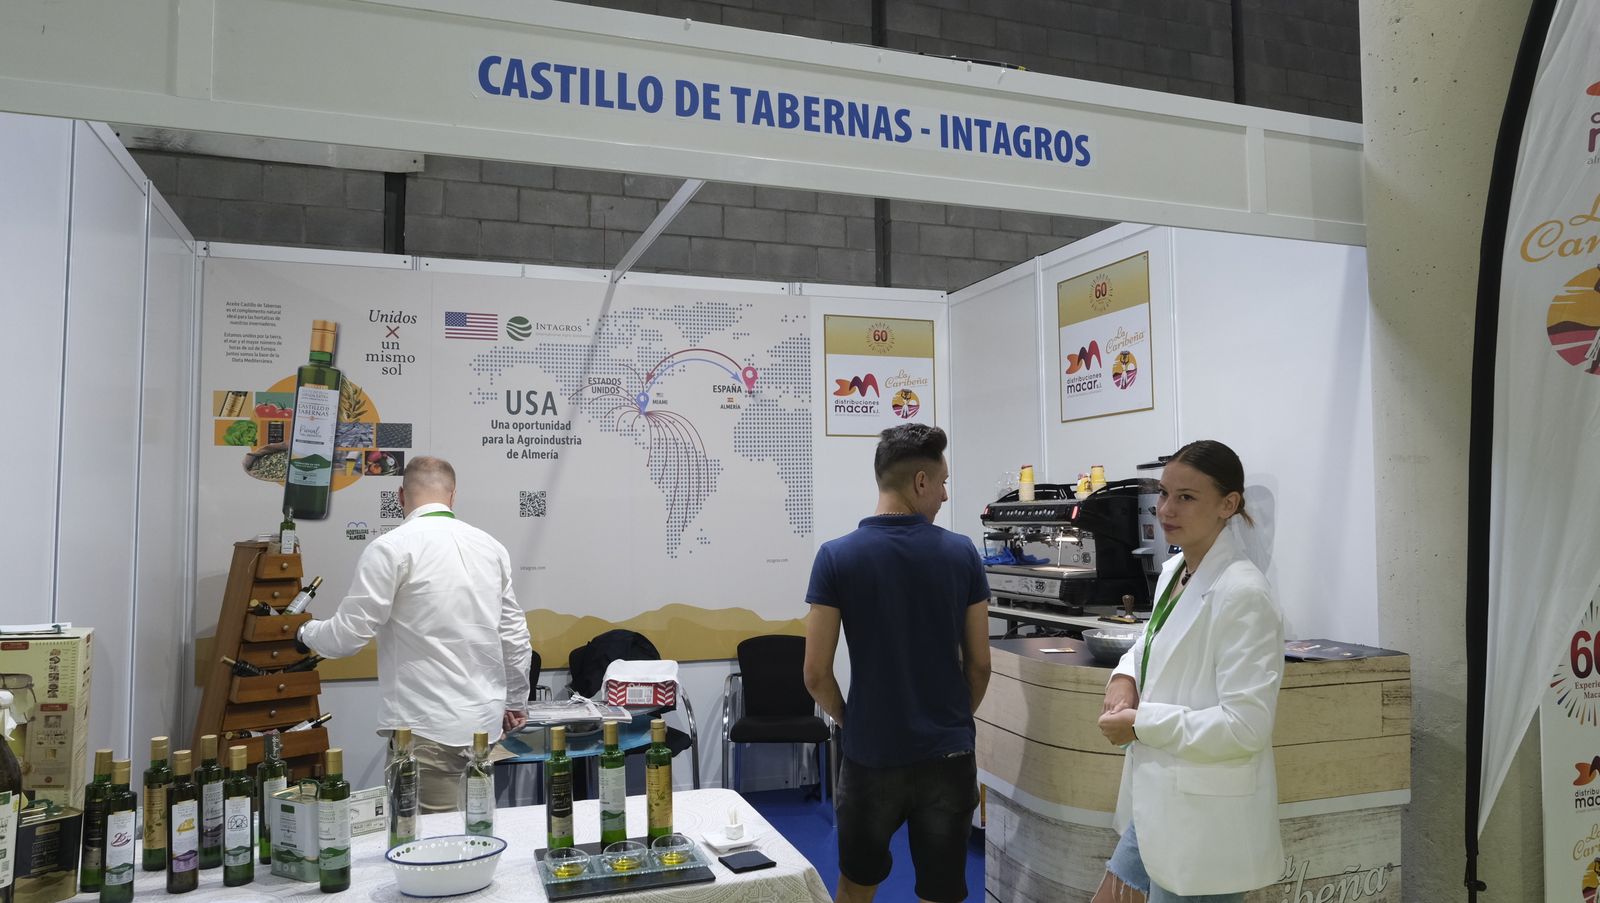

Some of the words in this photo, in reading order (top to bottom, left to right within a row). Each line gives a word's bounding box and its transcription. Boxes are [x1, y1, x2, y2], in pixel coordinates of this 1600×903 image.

[478, 55, 663, 114] CASTILLO
[675, 79, 721, 121] DE
[730, 86, 913, 144] TABERNAS
[940, 114, 1091, 167] INTAGROS
[1095, 282, 1107, 299] 60
[369, 310, 418, 324] Unidos
[536, 323, 582, 333] INTAGROS
[1114, 326, 1126, 341] La
[873, 330, 888, 342] 60
[381, 340, 400, 350] un
[1105, 331, 1145, 354] Caribeña
[365, 351, 416, 363] mismo
[382, 364, 402, 376] sol
[895, 369, 909, 380] La
[588, 377, 622, 386] ESTADOS
[885, 374, 929, 388] Caribeña
[1066, 373, 1102, 384] distribuciones
[591, 386, 620, 395] UNIDOS
[712, 383, 742, 393] ESPAÑA
[1067, 380, 1097, 394] macar
[506, 390, 558, 416] USA
[834, 404, 873, 413] macar
[491, 420, 510, 430] Una
[512, 420, 572, 432] oportunidad
[482, 436, 504, 447] para
[506, 434, 515, 445] la
[516, 435, 582, 447] Agroindustria
[506, 449, 519, 459] de
[521, 449, 559, 460] Almería
